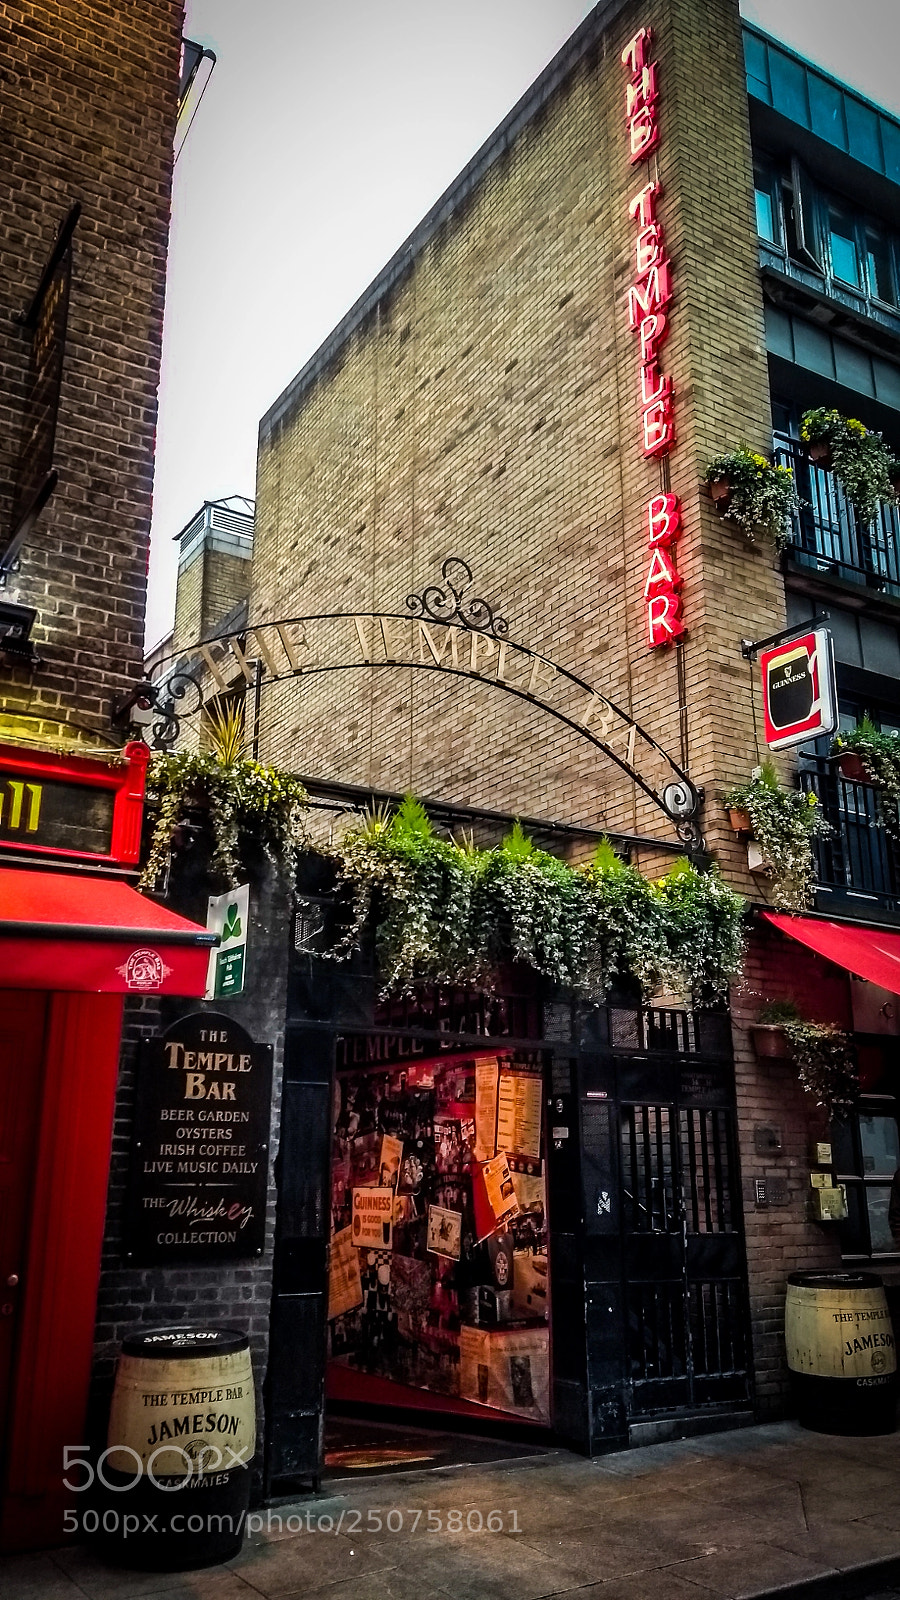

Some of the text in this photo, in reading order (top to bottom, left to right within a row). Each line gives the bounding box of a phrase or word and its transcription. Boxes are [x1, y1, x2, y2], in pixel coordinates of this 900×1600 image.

[620, 27, 683, 647] THE TEMPLE BAR
[183, 622, 318, 692] THE
[351, 615, 558, 701] TEMPLE
[772, 671, 806, 690] GUINNESS
[0, 780, 43, 831] ll
[200, 1029, 228, 1043] THE
[165, 1041, 253, 1073] TEMPLE
[184, 1072, 237, 1101] BAR
[160, 1109, 250, 1123] BEER GARDEN
[176, 1127, 233, 1140] OYSTERS
[159, 1144, 247, 1157] IRISH COFFEE
[143, 1161, 259, 1174] LIVE MUSIC DAILY
[354, 1193, 391, 1211] GUINNESS
[142, 1195, 255, 1229] THE Whiskey
[157, 1231, 237, 1244] COLLECTION
[833, 1313, 854, 1322] THE
[143, 1332, 219, 1343] JAMESON
[142, 1386, 244, 1407] THE TEMPLE BAR
[147, 1413, 240, 1445] JAMESON
